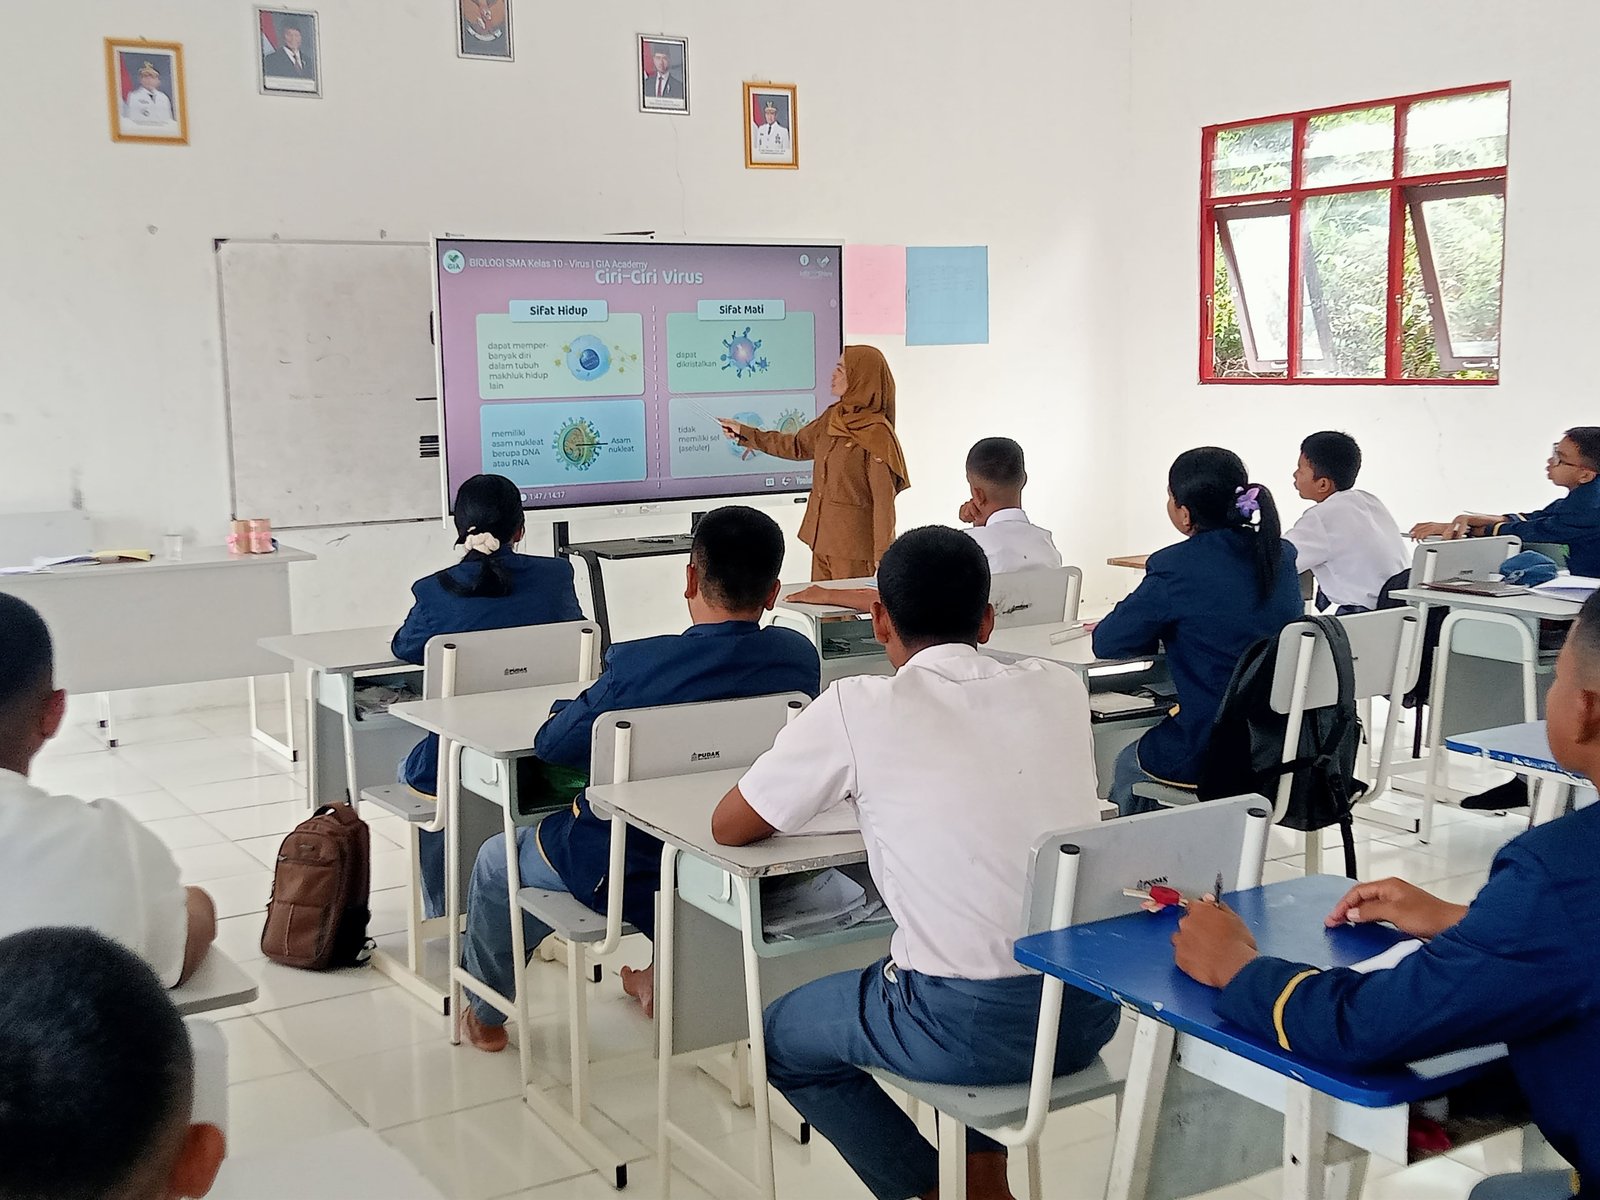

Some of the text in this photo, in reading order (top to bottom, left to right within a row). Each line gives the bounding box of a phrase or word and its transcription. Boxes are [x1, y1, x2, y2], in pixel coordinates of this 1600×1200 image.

[469, 258, 506, 268] BIOLOGI
[506, 258, 526, 268] SMA
[528, 259, 550, 268] Kelas
[553, 260, 563, 268] 10
[569, 260, 590, 268] Virus
[596, 260, 610, 269] GIA
[612, 260, 648, 270] Academy
[595, 270, 704, 284] Ciri-Ciri Virus
[530, 306, 588, 317] Sifat Hidup
[719, 304, 764, 315] Sifat Mati
[488, 342, 511, 351] dapat
[488, 352, 532, 362] banyak diri
[676, 351, 697, 360] dapat
[488, 362, 540, 370] dalam tubuh
[676, 360, 716, 368] dikristalkan
[489, 372, 548, 382] makhluk hidup
[489, 382, 504, 390] lain
[492, 429, 526, 438] memiliki
[678, 434, 708, 442] memiliki
[514, 438, 544, 447] nukleat
[608, 444, 634, 453] nukleat
[678, 444, 710, 454] (aseluler)
[492, 449, 541, 459] berupa DNA
[492, 459, 530, 468] atau RNA
